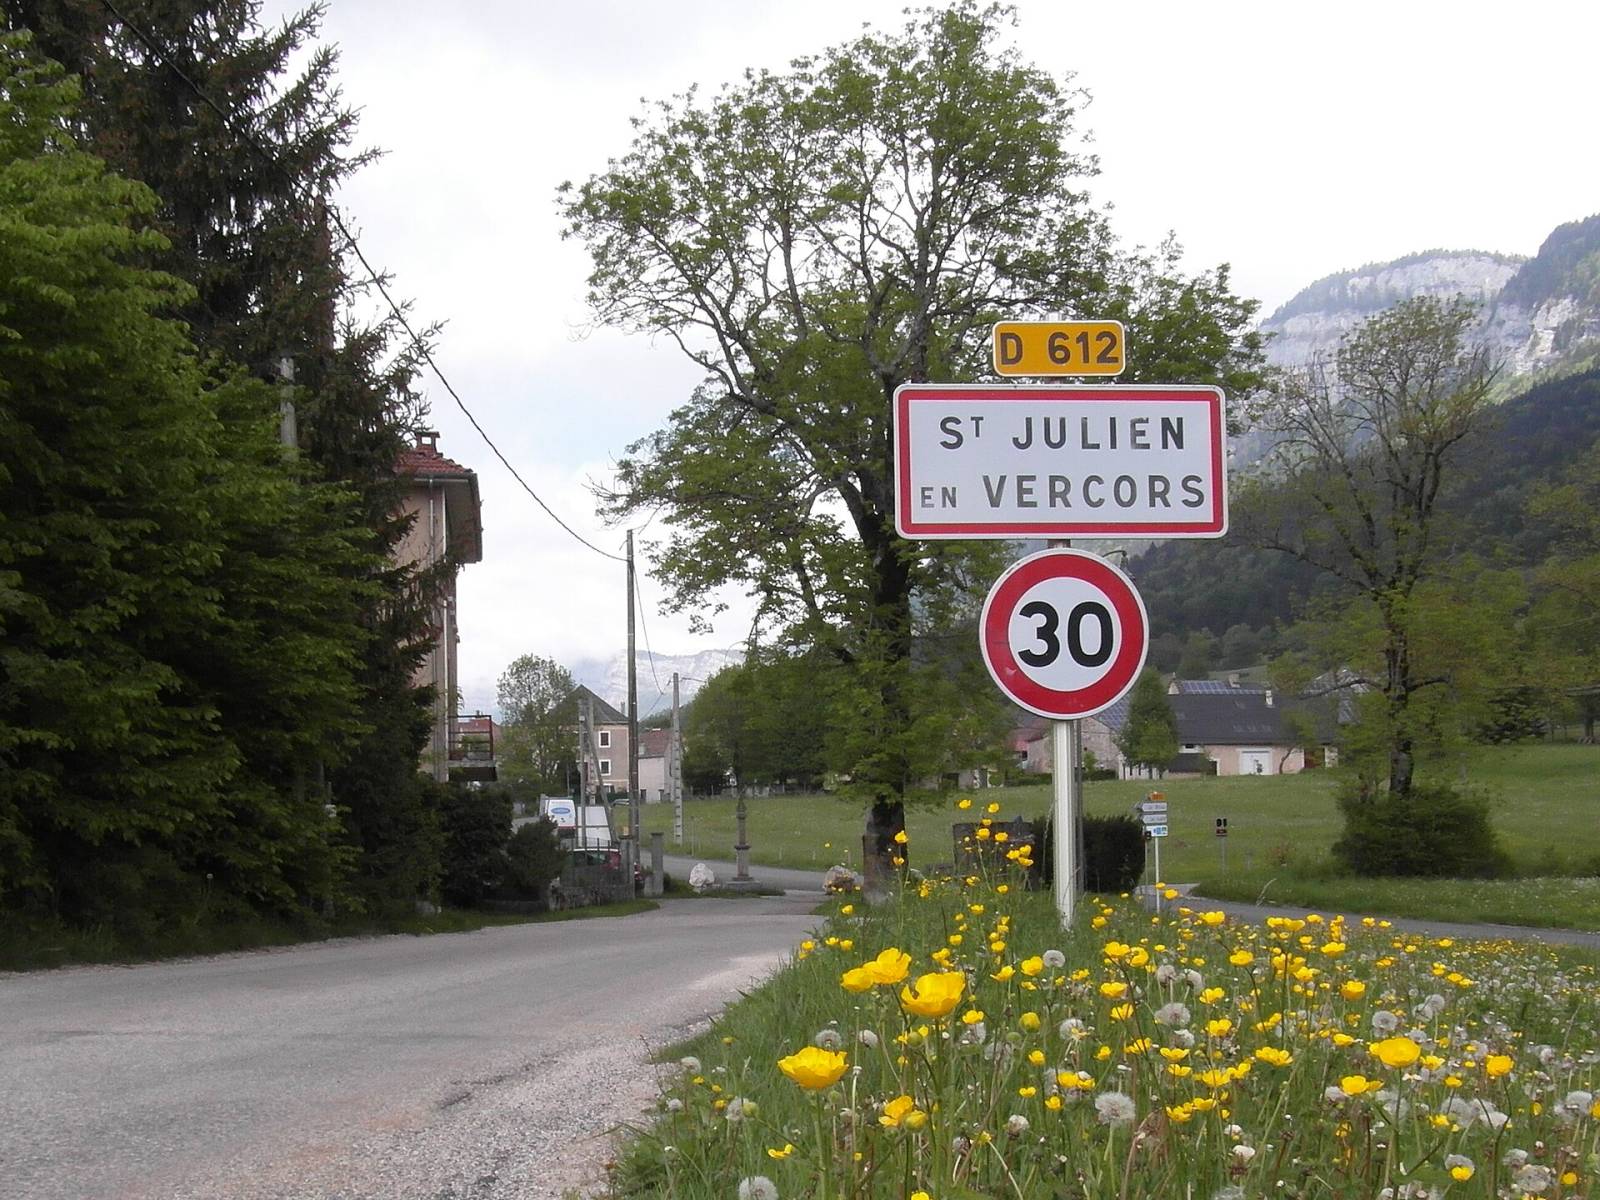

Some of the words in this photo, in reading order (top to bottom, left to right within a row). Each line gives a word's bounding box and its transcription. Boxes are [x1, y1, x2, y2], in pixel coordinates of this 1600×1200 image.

[1000, 332, 1023, 365] D
[1048, 331, 1120, 365] 612
[1012, 416, 1184, 450] JULIEN
[921, 486, 957, 508] EN
[982, 474, 1205, 508] VERCORS
[1018, 601, 1114, 668] 30
